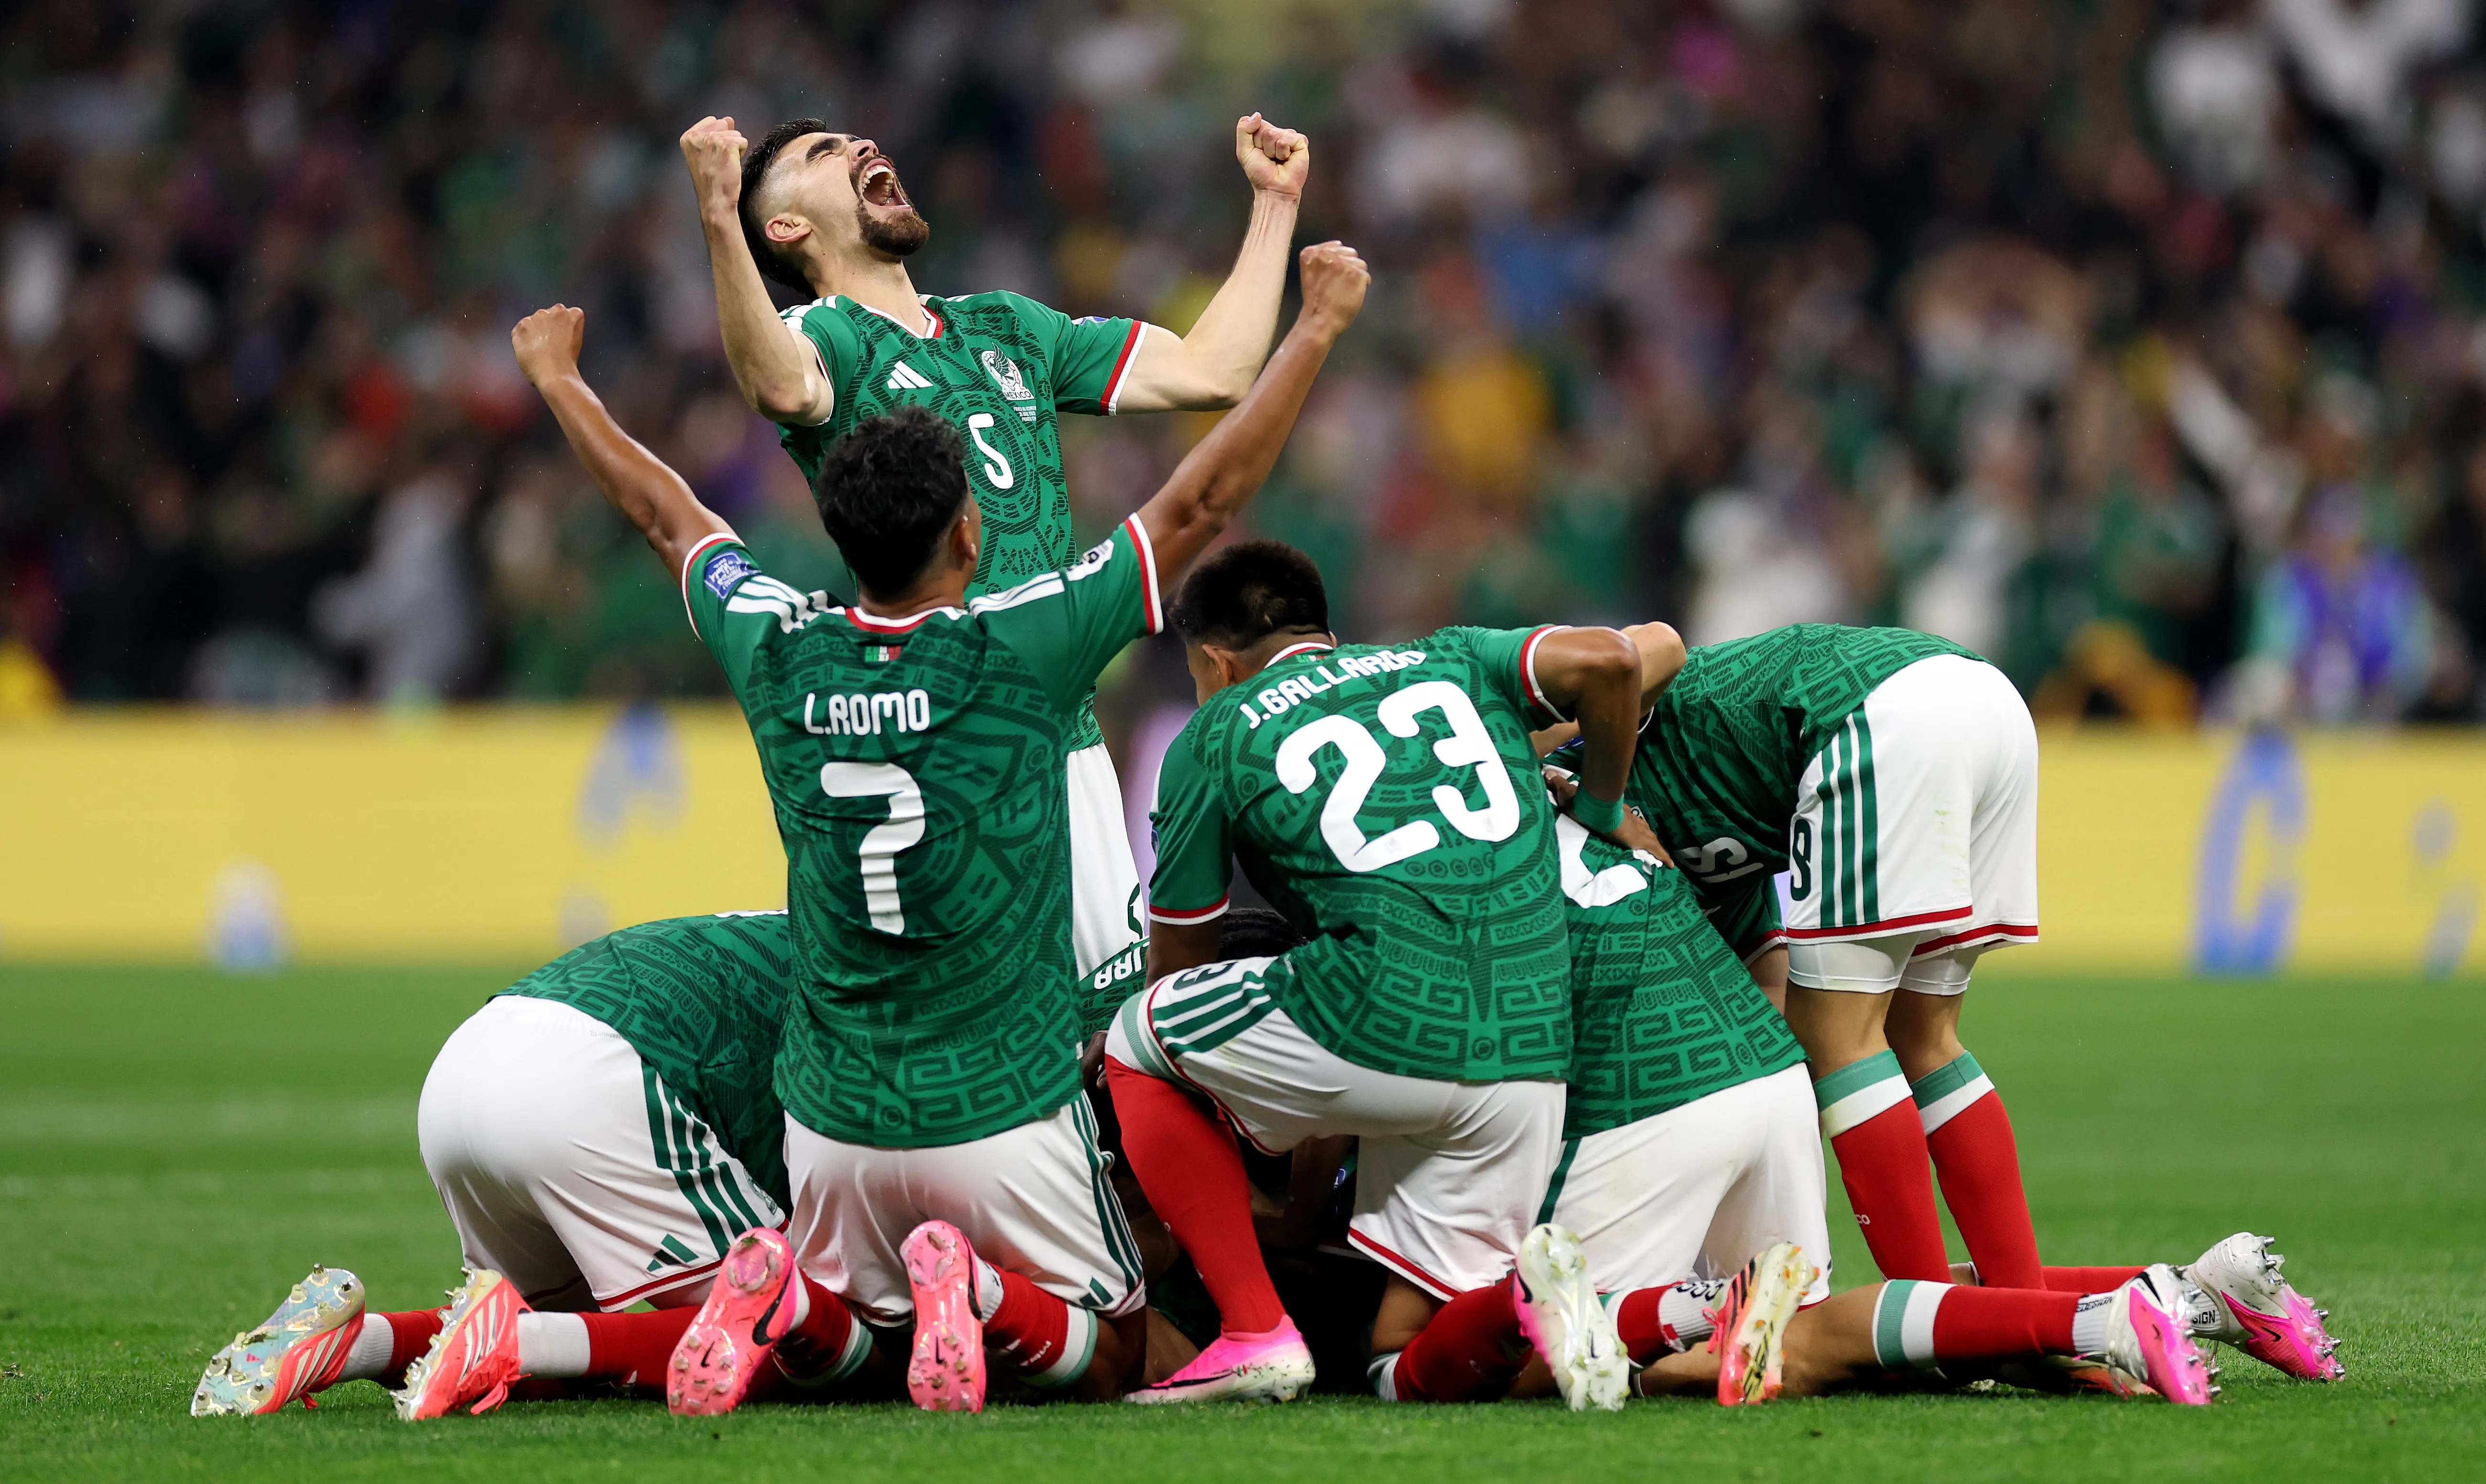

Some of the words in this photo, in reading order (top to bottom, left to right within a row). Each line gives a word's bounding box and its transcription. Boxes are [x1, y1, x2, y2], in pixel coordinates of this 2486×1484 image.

[968, 413, 1014, 489] 5
[804, 689, 930, 736] L.ROMO
[1239, 650, 1427, 729] J.GALLARDO
[1275, 681, 1520, 873] 23
[820, 762, 926, 935] 7
[1094, 940, 1150, 989] IRA
